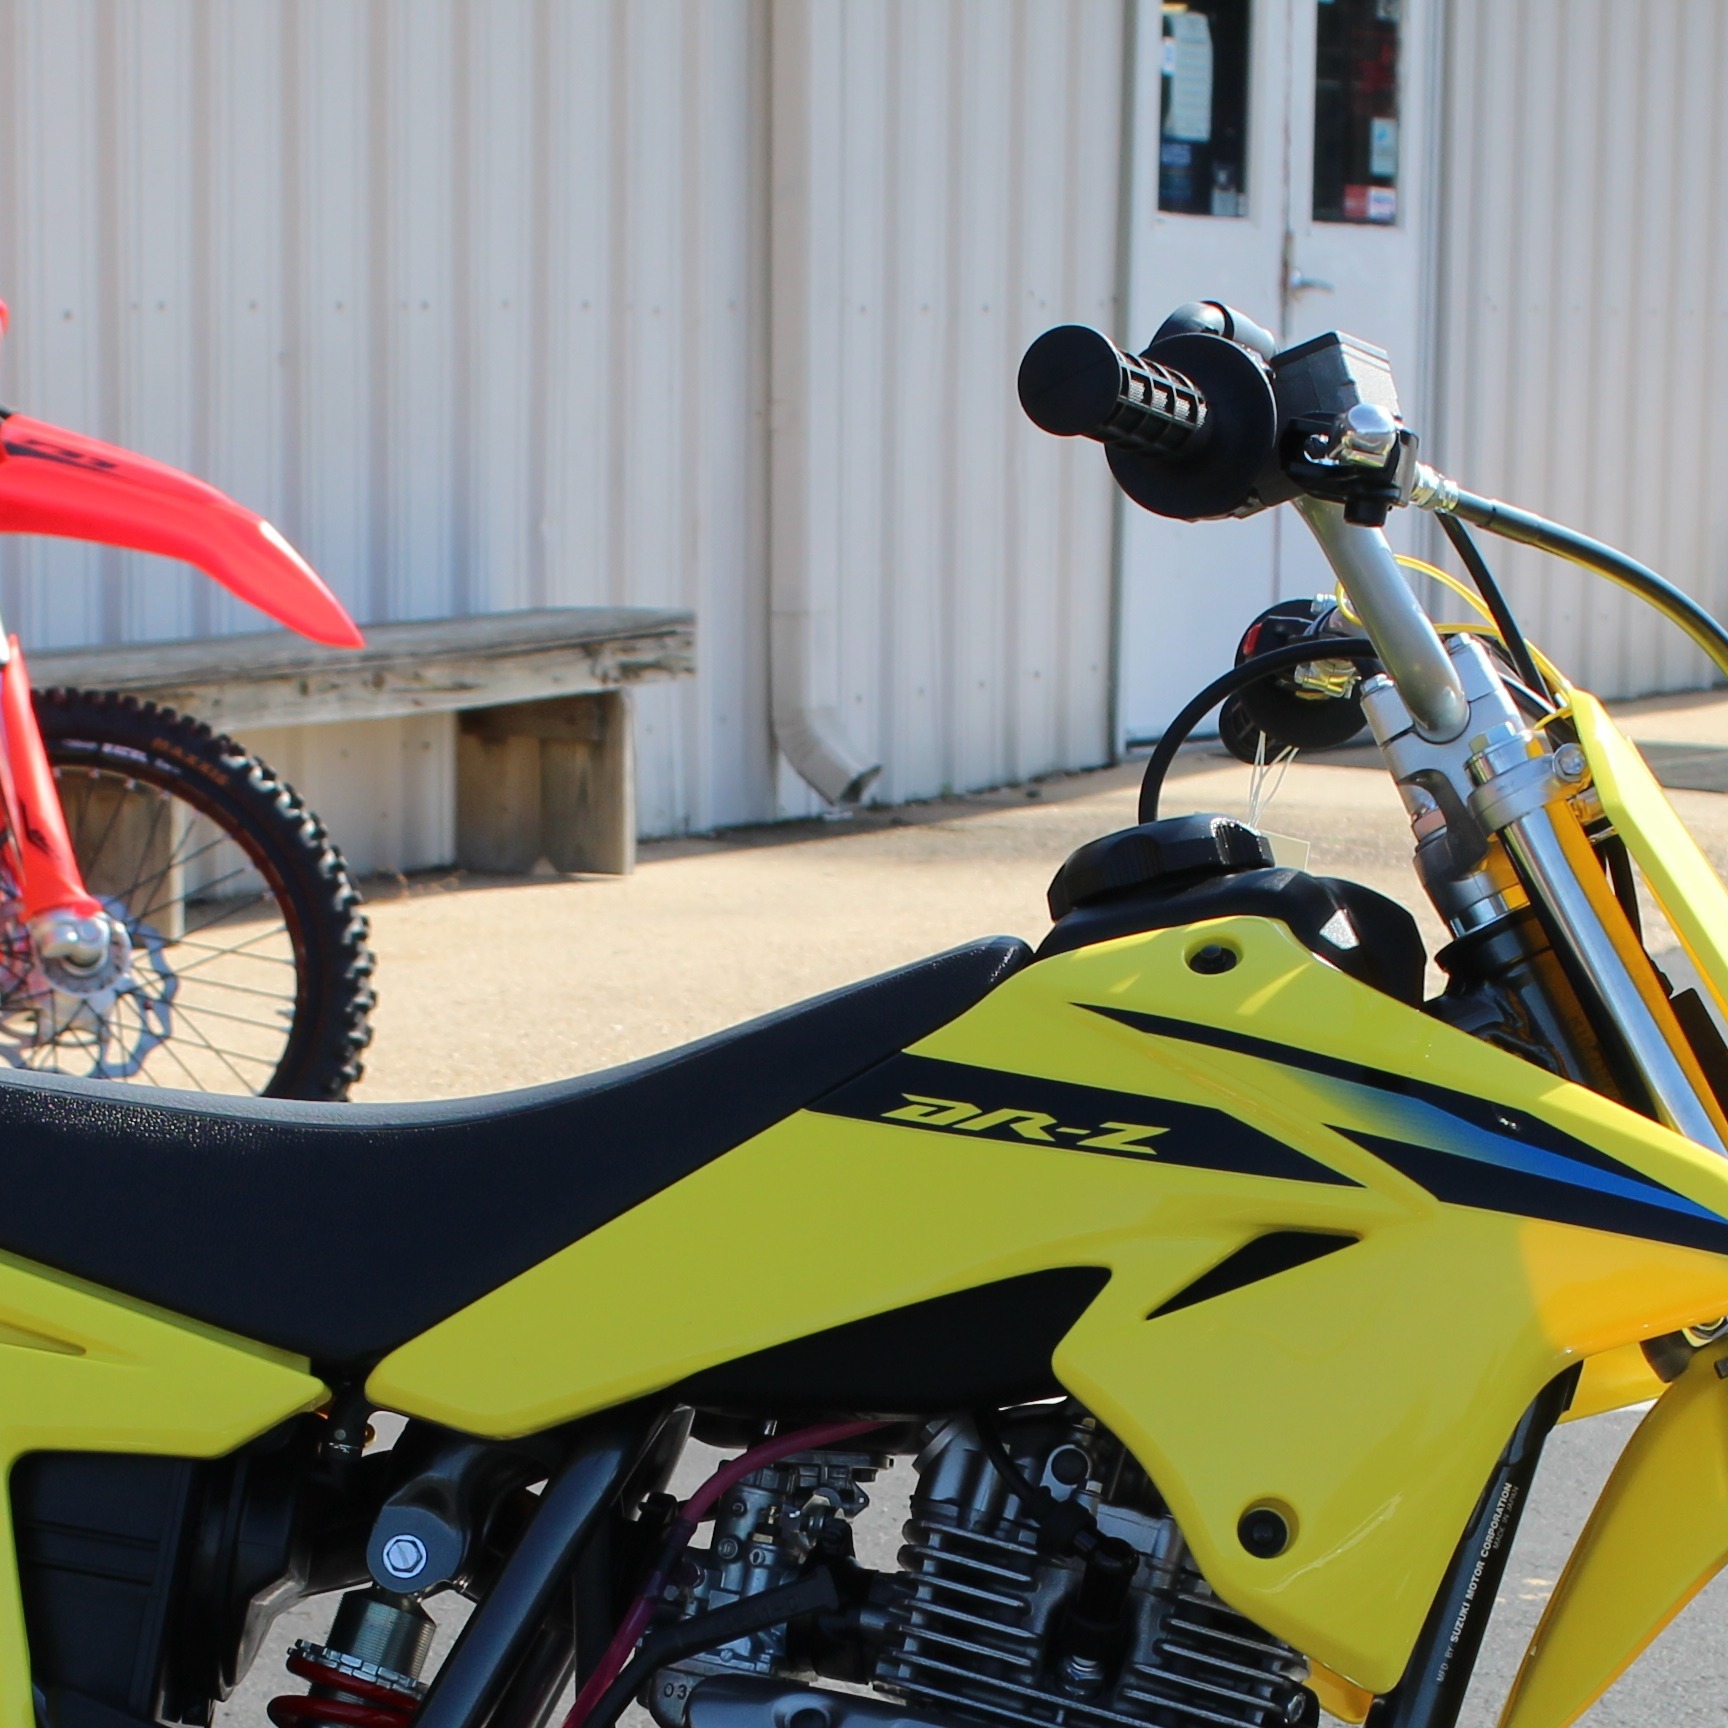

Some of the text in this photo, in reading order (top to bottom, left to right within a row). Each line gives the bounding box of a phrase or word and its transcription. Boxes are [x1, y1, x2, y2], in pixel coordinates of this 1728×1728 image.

[880, 1092, 1172, 1156] DR-Z
[1450, 1602, 1471, 1644] SUZUKI
[1465, 1560, 1486, 1602] MOTOR
[1480, 1482, 1513, 1559] CORPORATION
